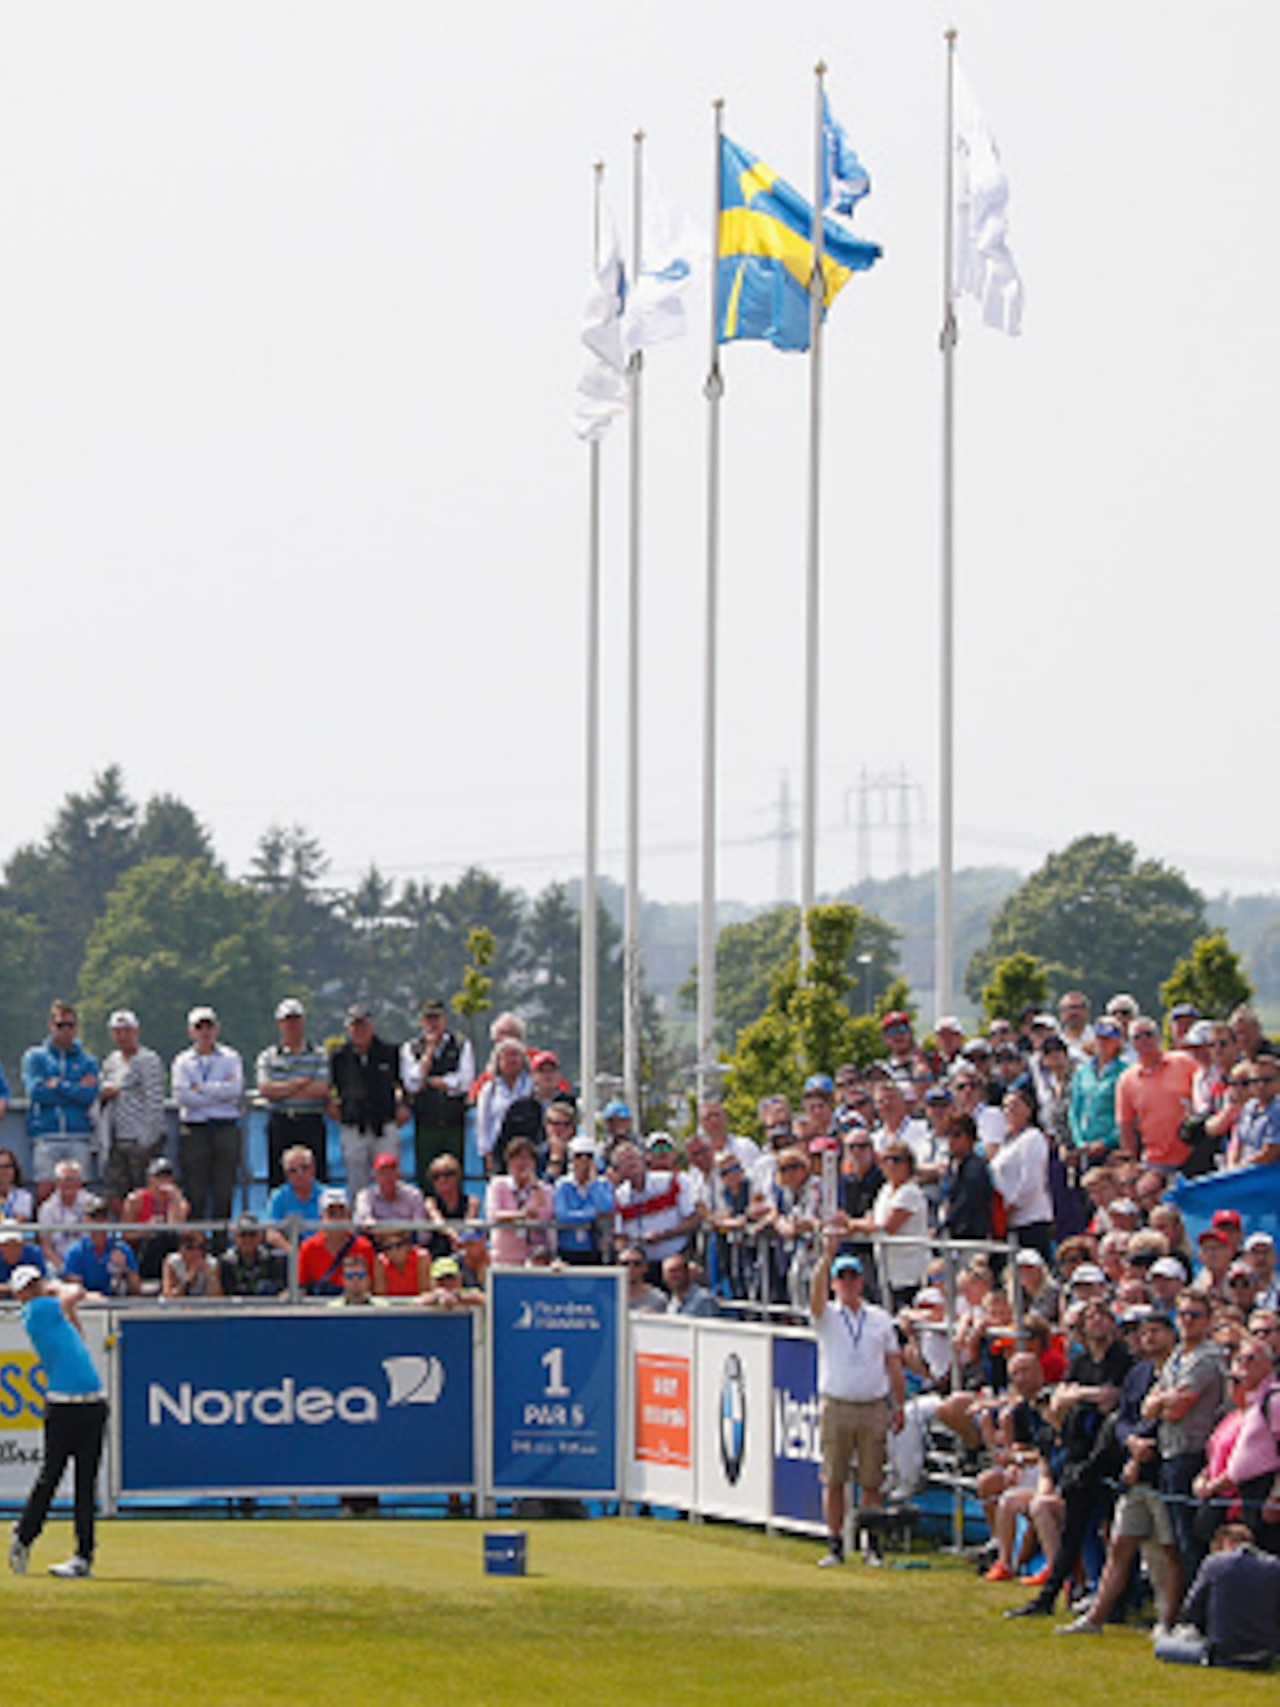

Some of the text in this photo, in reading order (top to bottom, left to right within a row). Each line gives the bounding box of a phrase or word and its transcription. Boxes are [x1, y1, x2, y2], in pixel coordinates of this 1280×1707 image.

[541, 1346, 570, 1397] 1
[149, 1376, 378, 1425] Nordea
[523, 1403, 585, 1427] PAR 5
